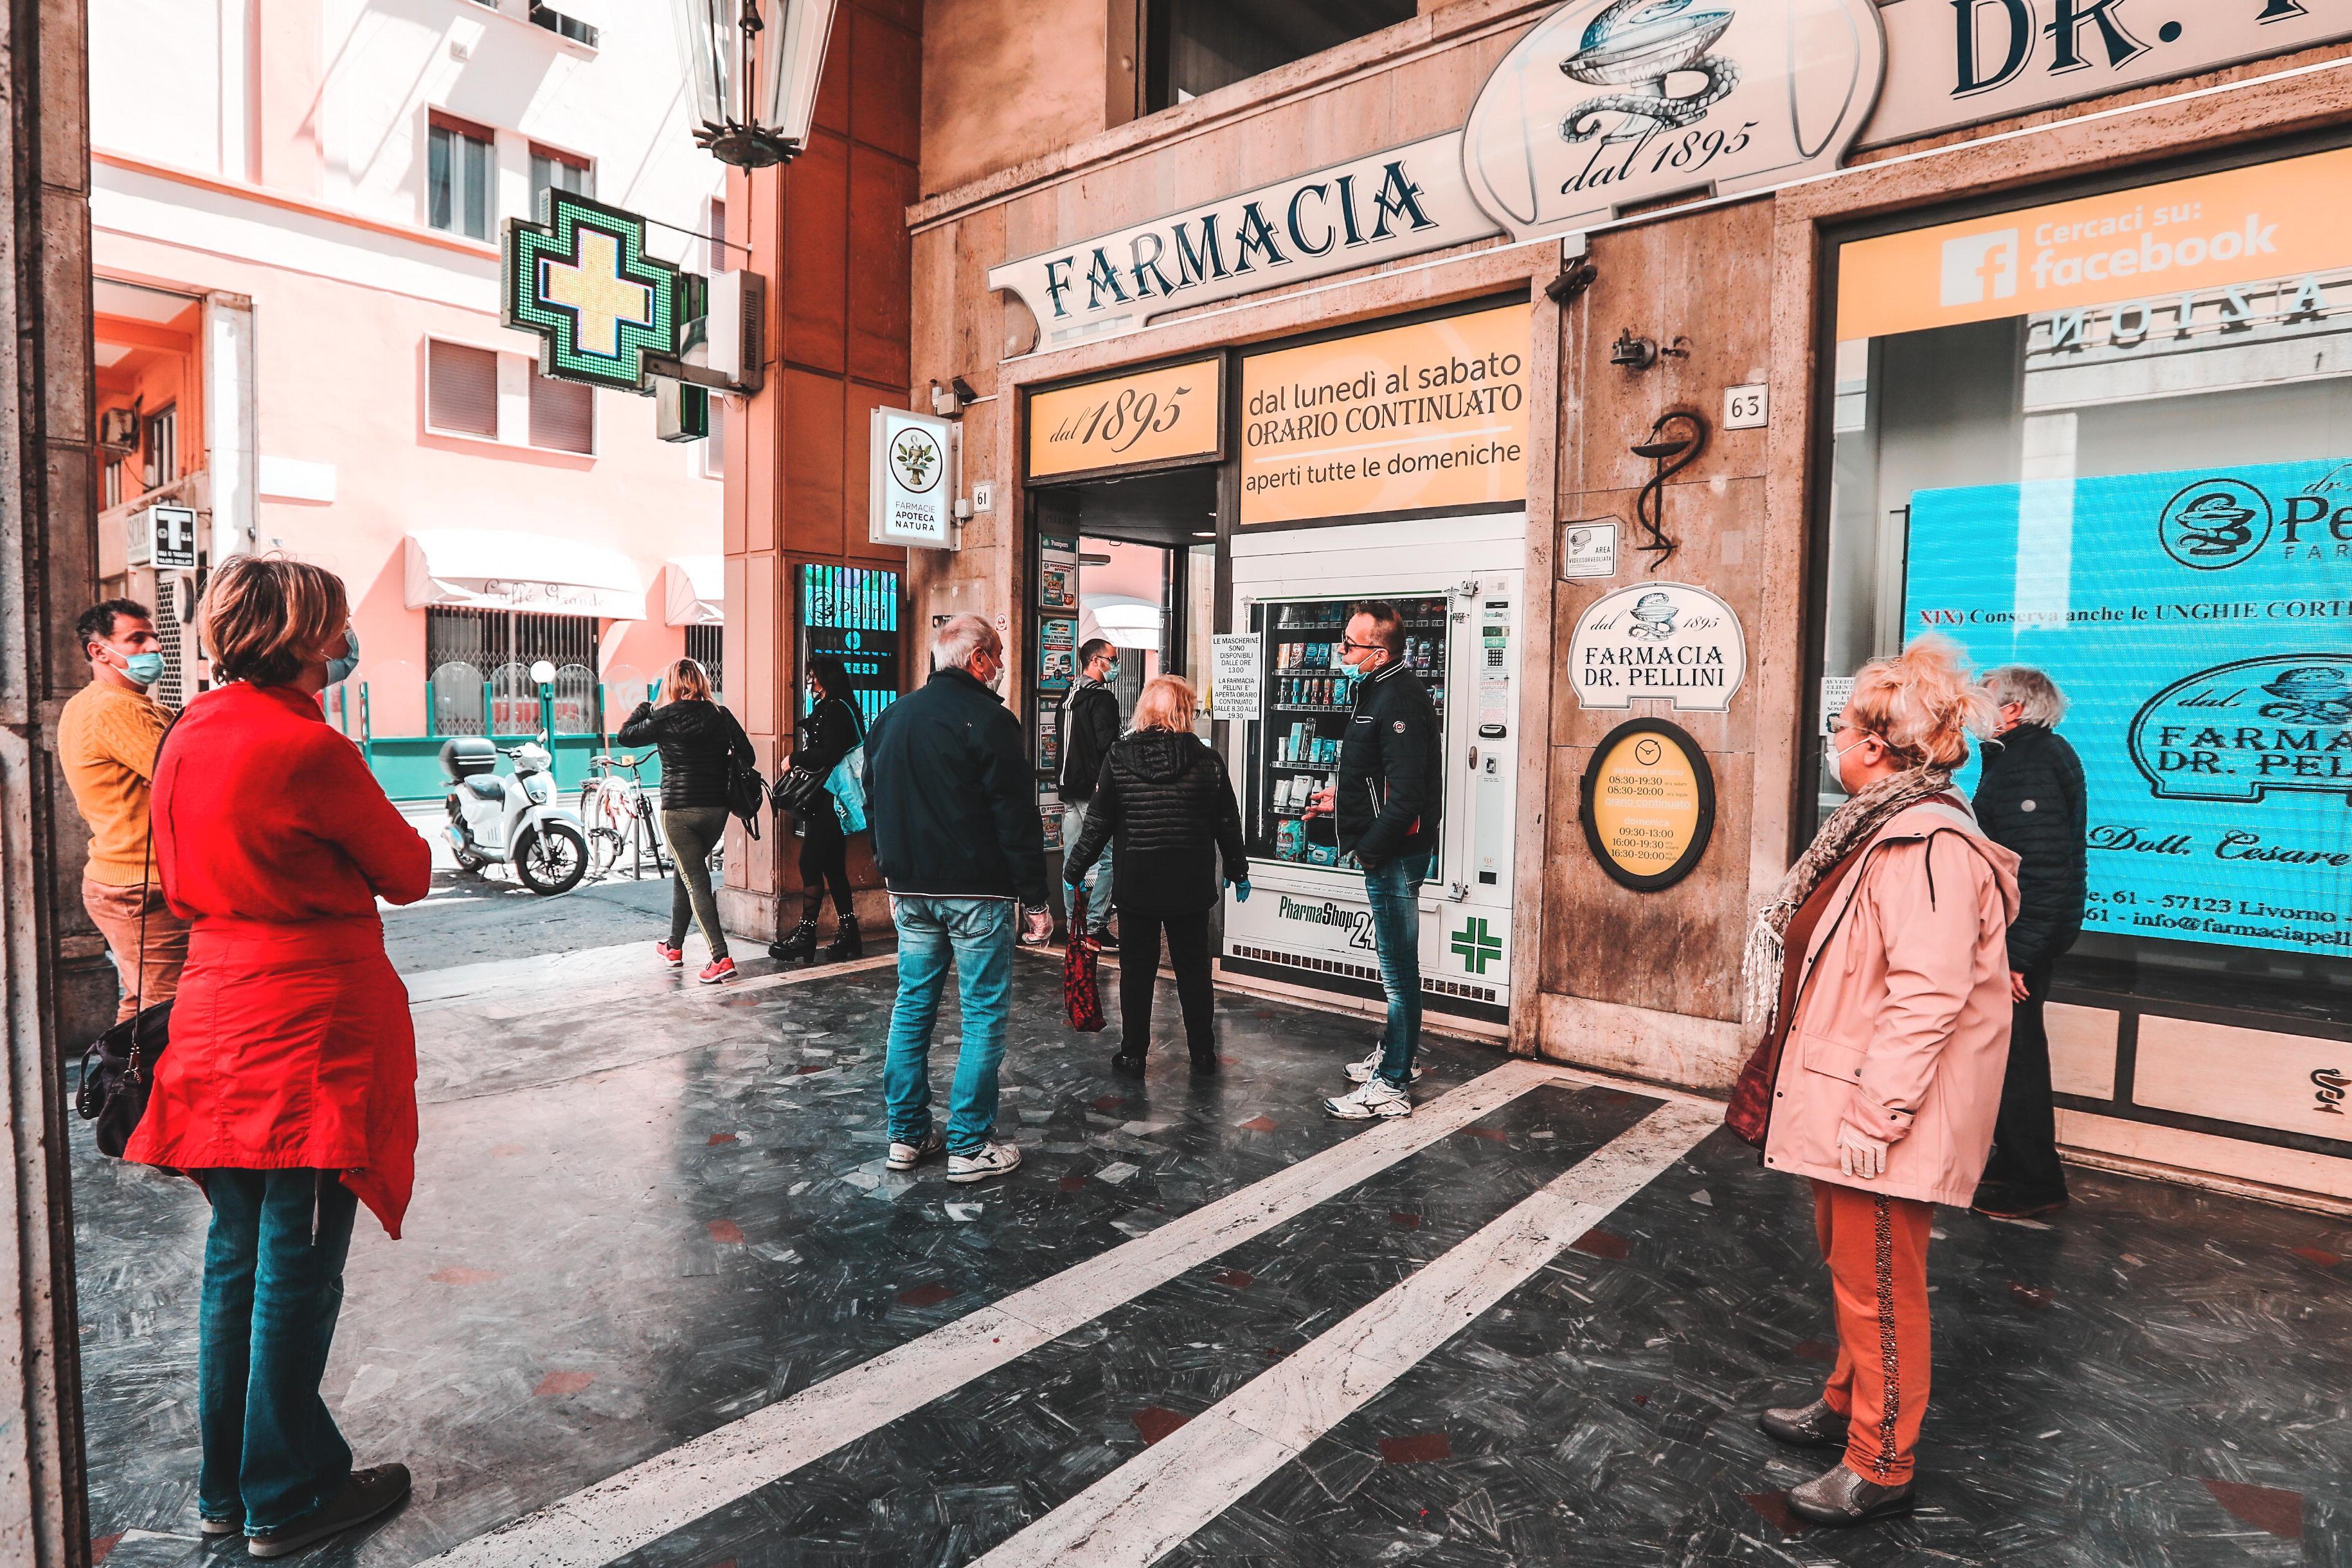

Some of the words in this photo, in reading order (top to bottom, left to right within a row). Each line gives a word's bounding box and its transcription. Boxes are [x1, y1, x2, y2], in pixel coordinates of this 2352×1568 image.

[1950, 0, 2183, 101] DR.
[1560, 114, 1666, 195] dal
[1650, 120, 1760, 173] 1895
[2034, 205, 2144, 249] Cercaci
[2153, 202, 2202, 228] su:
[1045, 159, 1439, 321] FARMACIA
[2031, 213, 2280, 290] facebook
[1249, 386, 1286, 416] dal
[1294, 370, 1377, 407] lunedì
[1386, 364, 1409, 394] al
[1418, 352, 1522, 390] sabato
[1246, 411, 1338, 448] ORARIO
[1345, 383, 1523, 434] CONTINUATO
[1732, 395, 1759, 418] 63
[1049, 406, 1091, 443] dal
[1082, 386, 1192, 454] 1895
[1246, 464, 1302, 493] aperti
[1307, 458, 1356, 485] tutte
[1362, 454, 1381, 478] le
[1387, 441, 1522, 475] domeniche
[895, 501, 936, 513] FARMACIE
[977, 492, 987, 505] 61
[895, 511, 935, 522] APOTECA
[895, 520, 935, 532] NATURA
[156, 510, 192, 551] T
[1050, 539, 1068, 548] Pampers
[544, 582, 607, 608] Grande
[1590, 609, 1628, 631] dal
[1683, 615, 1721, 631] 1895
[1970, 609, 2060, 624] Conserva
[2066, 606, 2124, 622] anche
[2132, 605, 2148, 620] le
[2156, 602, 2258, 620] UNGHIE
[1584, 646, 1725, 666] FARMACIA
[1584, 668, 1620, 688] DR.
[1628, 668, 1725, 688] PELLINI
[2158, 750, 2237, 774] DR.
[1607, 785, 1664, 796] 08:30-20:00
[1609, 776, 1663, 786] 08:30-19:30
[1604, 797, 1633, 807] orario
[1635, 799, 1691, 809] continuato
[1619, 827, 1674, 838] 09:30-13:00
[1624, 817, 1670, 827] domenica
[1611, 849, 1665, 860] 16:30-20:00
[1612, 838, 1664, 849] 16:00-19:30
[2215, 829, 2351, 866] Cesare
[2113, 889, 2137, 905] 61
[2162, 894, 2231, 913] 57123
[2238, 900, 2336, 923] Livorno
